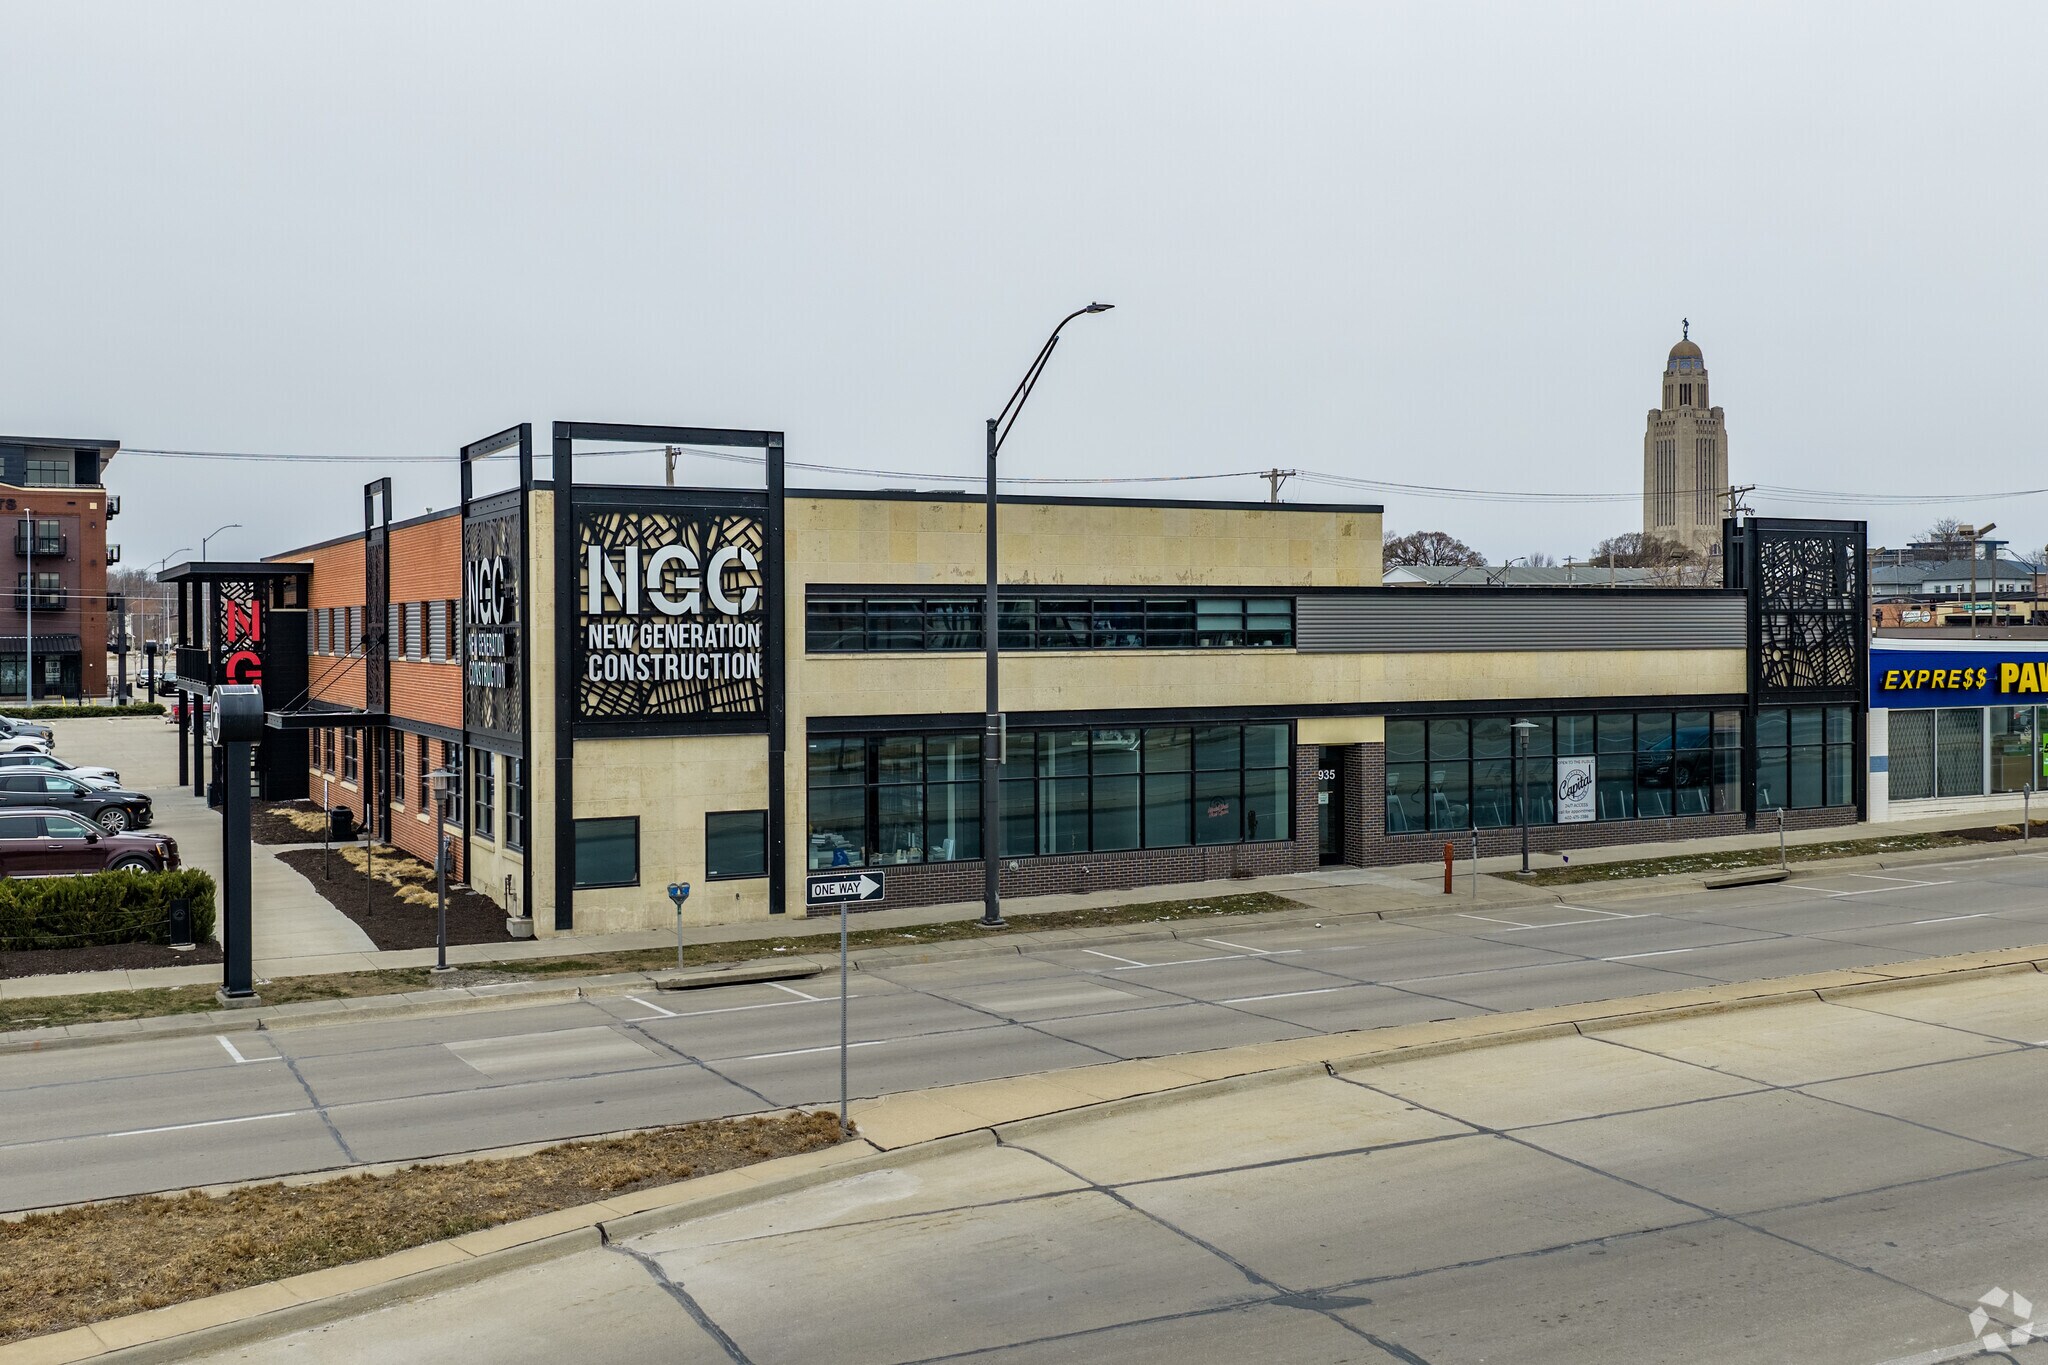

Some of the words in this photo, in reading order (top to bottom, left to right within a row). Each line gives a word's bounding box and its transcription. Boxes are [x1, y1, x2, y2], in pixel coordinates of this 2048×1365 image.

[468, 555, 505, 626] NGC
[587, 544, 759, 616] NGC
[588, 624, 634, 650] NEW
[640, 623, 761, 649] GENERATION
[588, 652, 761, 682] CONSTRUCTION
[1884, 667, 1988, 691] EXPRE$$
[1318, 769, 1336, 780] 935
[1559, 764, 1592, 801] Capital
[814, 884, 836, 896] ONE
[839, 881, 861, 894] WAY
